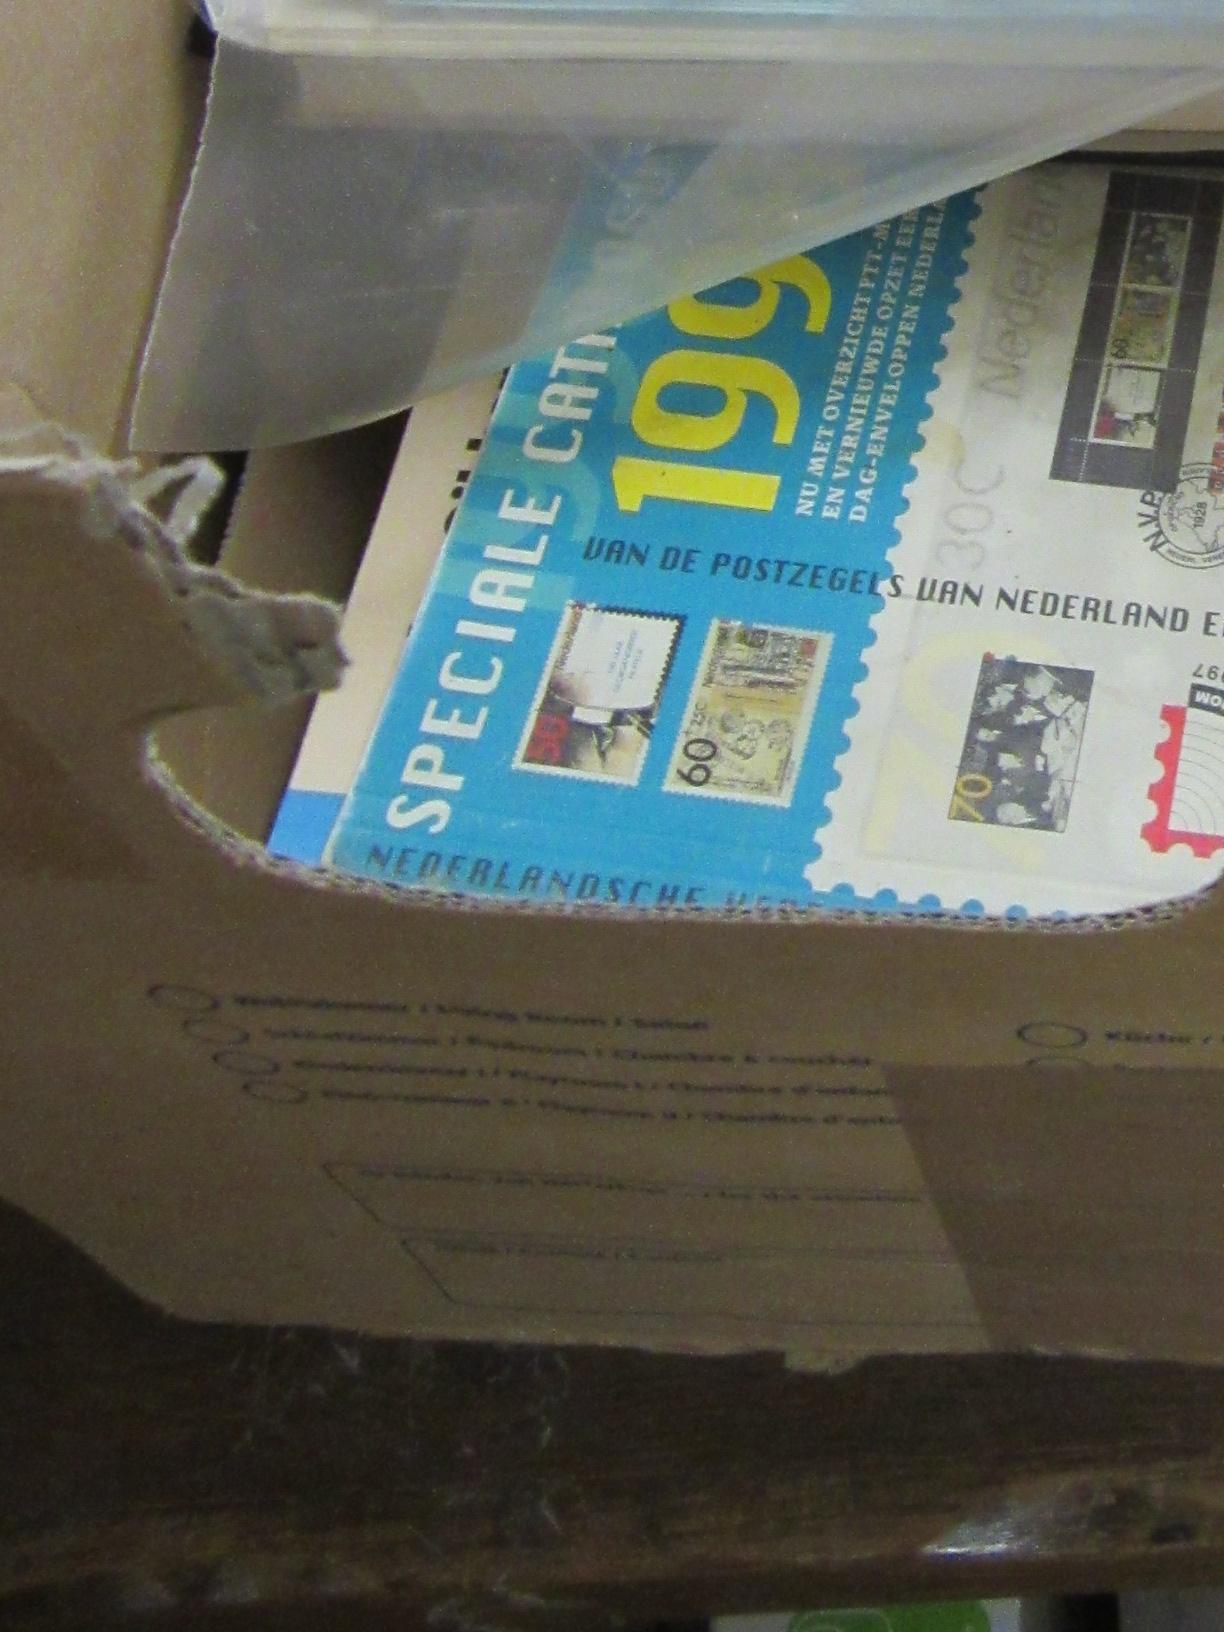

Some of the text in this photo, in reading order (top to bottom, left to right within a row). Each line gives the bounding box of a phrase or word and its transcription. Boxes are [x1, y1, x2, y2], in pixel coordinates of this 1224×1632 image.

[878, 249, 906, 321] OPZET
[821, 302, 870, 420] OVERZICHT
[832, 322, 888, 478] VERNIEUWDE
[850, 299, 918, 523] DAG-ENVELOPPEN
[808, 425, 836, 477] MET
[794, 485, 819, 517] NU
[821, 484, 845, 521] EN
[583, 536, 645, 567] VAN
[660, 547, 699, 576] DE
[711, 552, 904, 598] POSTZEGELS
[918, 576, 984, 607] VAN
[995, 582, 1190, 633] NEDERLAND
[386, 487, 562, 835] SPECIALE
[676, 737, 718, 788] 60
[951, 773, 993, 822] 70
